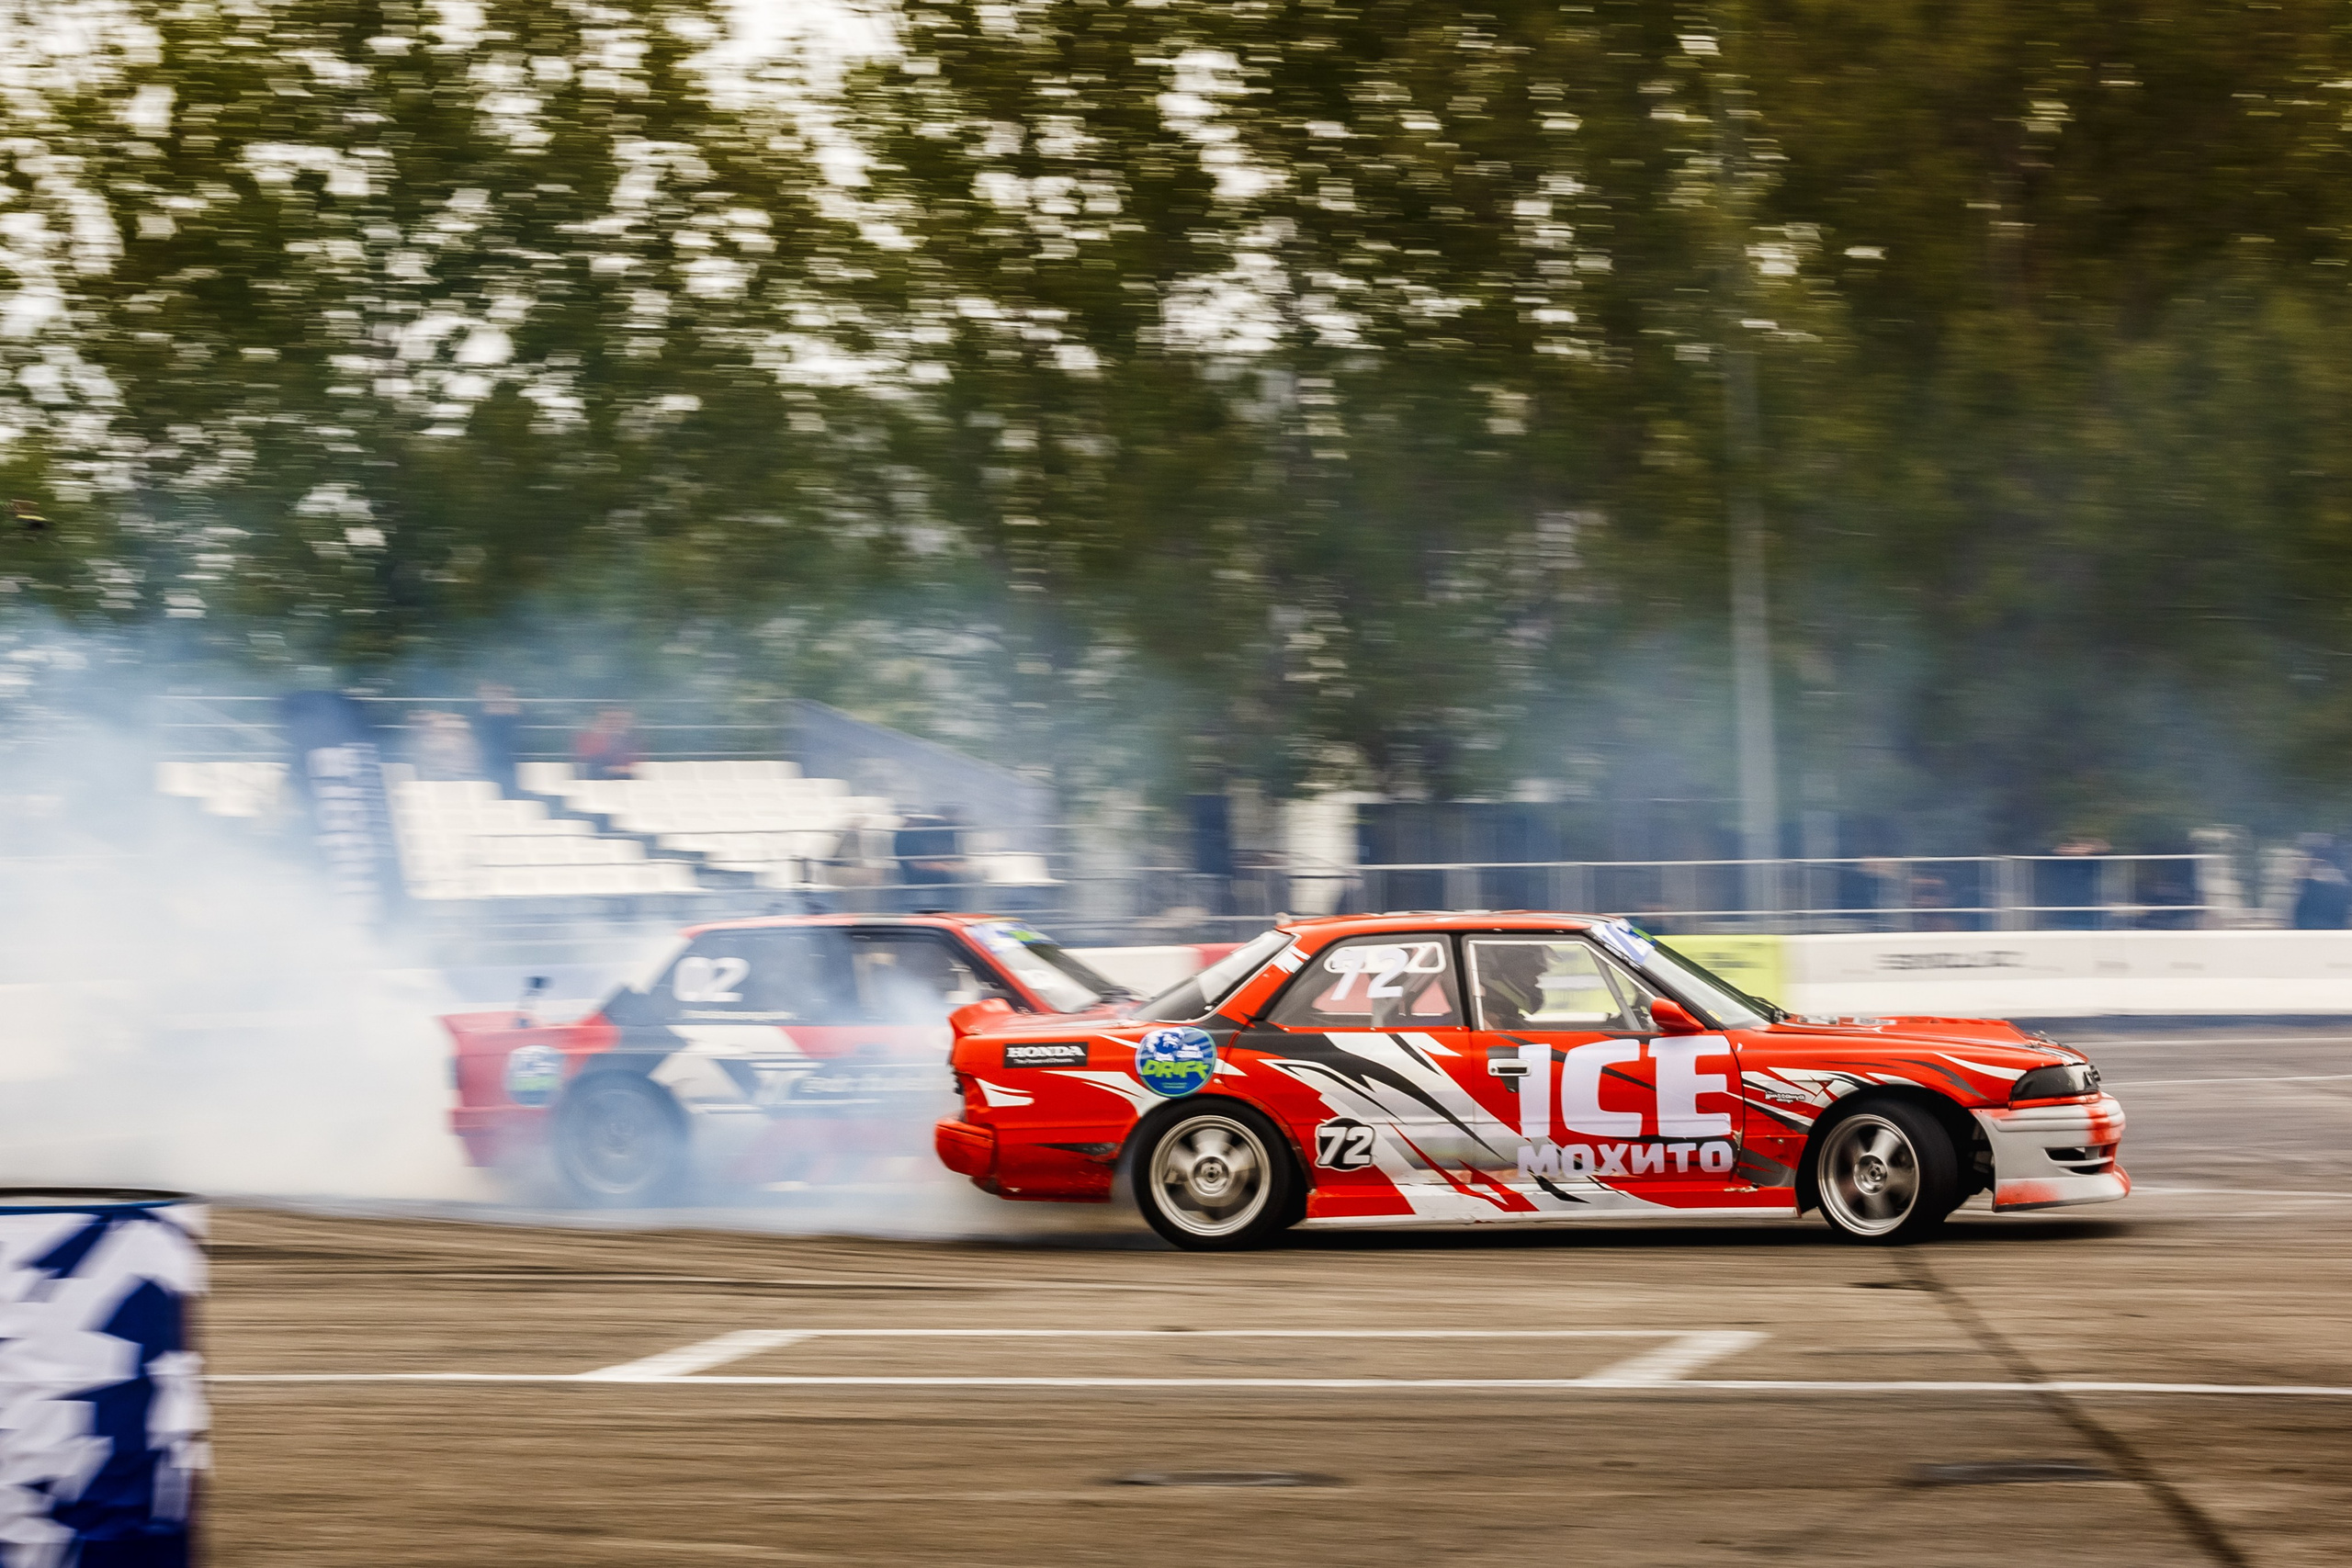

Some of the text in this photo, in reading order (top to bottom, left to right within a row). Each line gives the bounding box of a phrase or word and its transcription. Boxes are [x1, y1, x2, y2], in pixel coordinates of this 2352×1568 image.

[1331, 948, 1409, 1000] 72
[1006, 1046, 1086, 1057] HONDA
[1142, 1060, 1209, 1079] DRIFT
[1518, 1035, 1731, 1137] ICE
[1317, 1126, 1374, 1166] 72
[1518, 1141, 1733, 1178] МОХИТО
